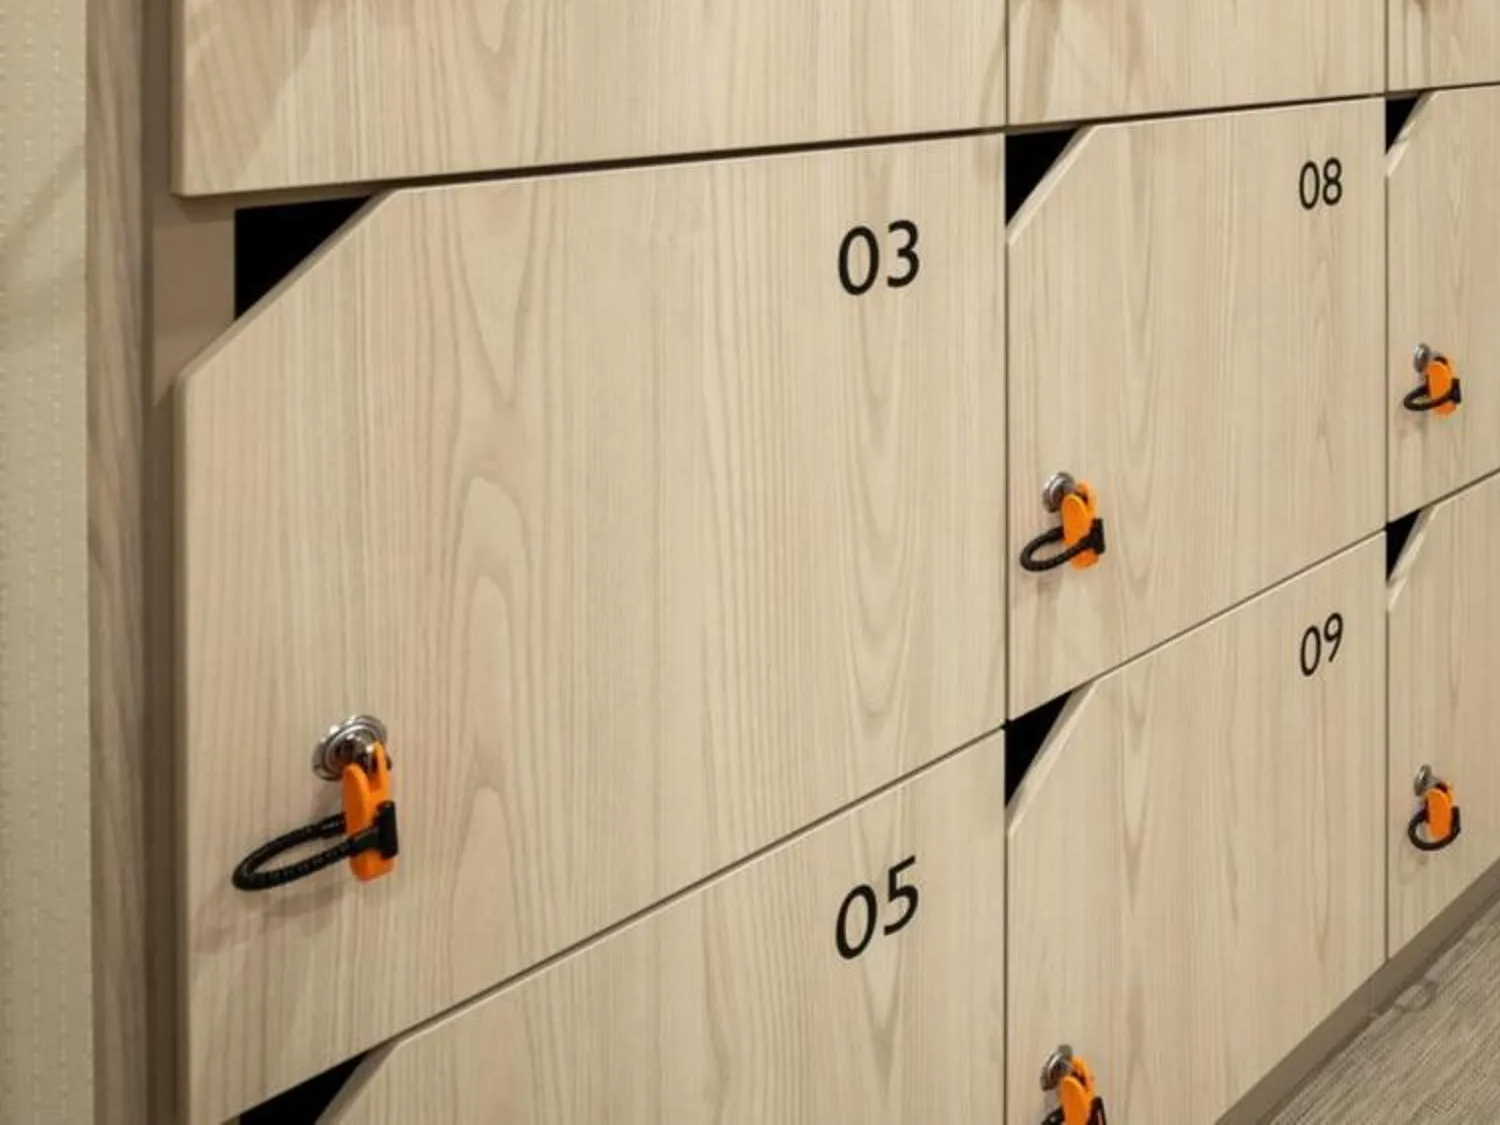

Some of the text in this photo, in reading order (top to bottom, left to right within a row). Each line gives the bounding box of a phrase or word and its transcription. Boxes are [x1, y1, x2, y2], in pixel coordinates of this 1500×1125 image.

[1298, 156, 1343, 211] 08
[837, 219, 920, 296] 03
[1299, 612, 1344, 677] 09
[835, 854, 919, 960] 05
